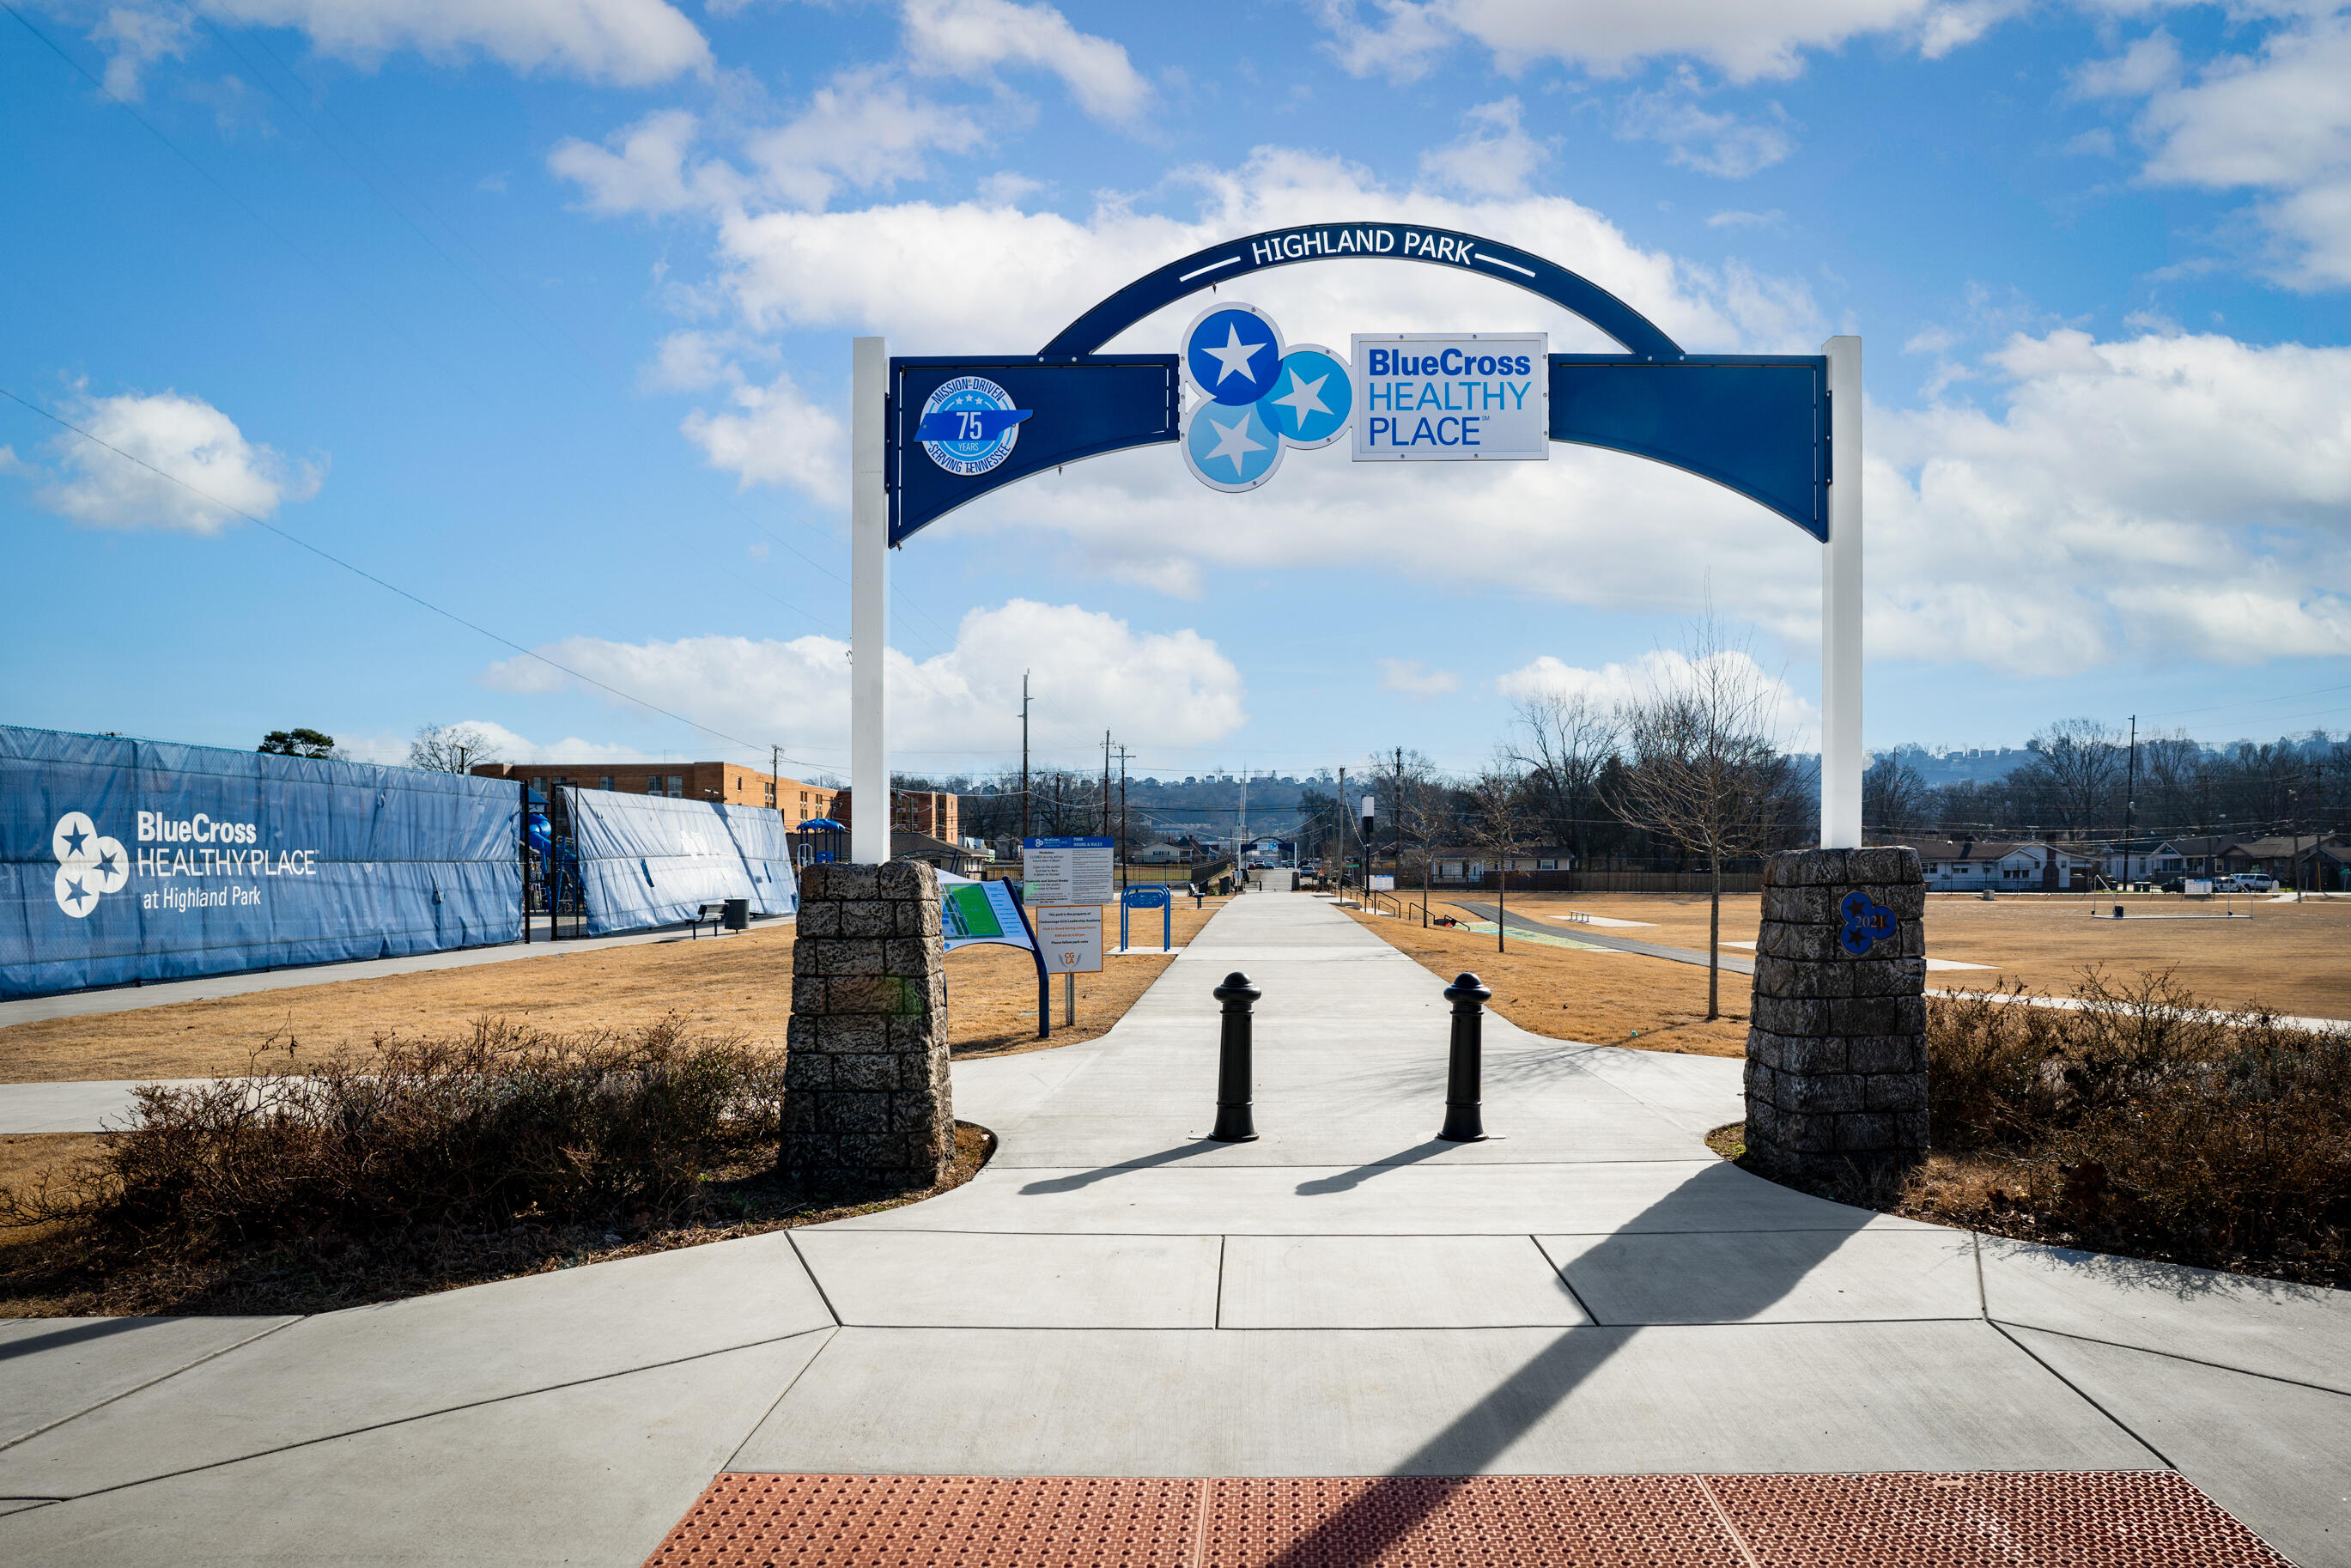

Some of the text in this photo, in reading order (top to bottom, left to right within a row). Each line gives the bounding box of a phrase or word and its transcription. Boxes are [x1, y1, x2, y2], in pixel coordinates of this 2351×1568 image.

[1252, 229, 1474, 264] HIGHLAND PARK
[1369, 348, 1531, 376] BlueCross
[932, 378, 1005, 404] MISSION-DRIVEN
[1369, 381, 1532, 411] HEALTHY
[956, 411, 982, 440] 75
[1370, 416, 1480, 447] PLACE
[928, 443, 1011, 473] SERVING TENNESSEE
[958, 442, 979, 451] YEARS
[137, 811, 257, 844] BlueCross
[137, 848, 317, 877] HEALTHY PLACE
[143, 886, 261, 913] at Highland Park
[1855, 915, 1884, 927] 2021
